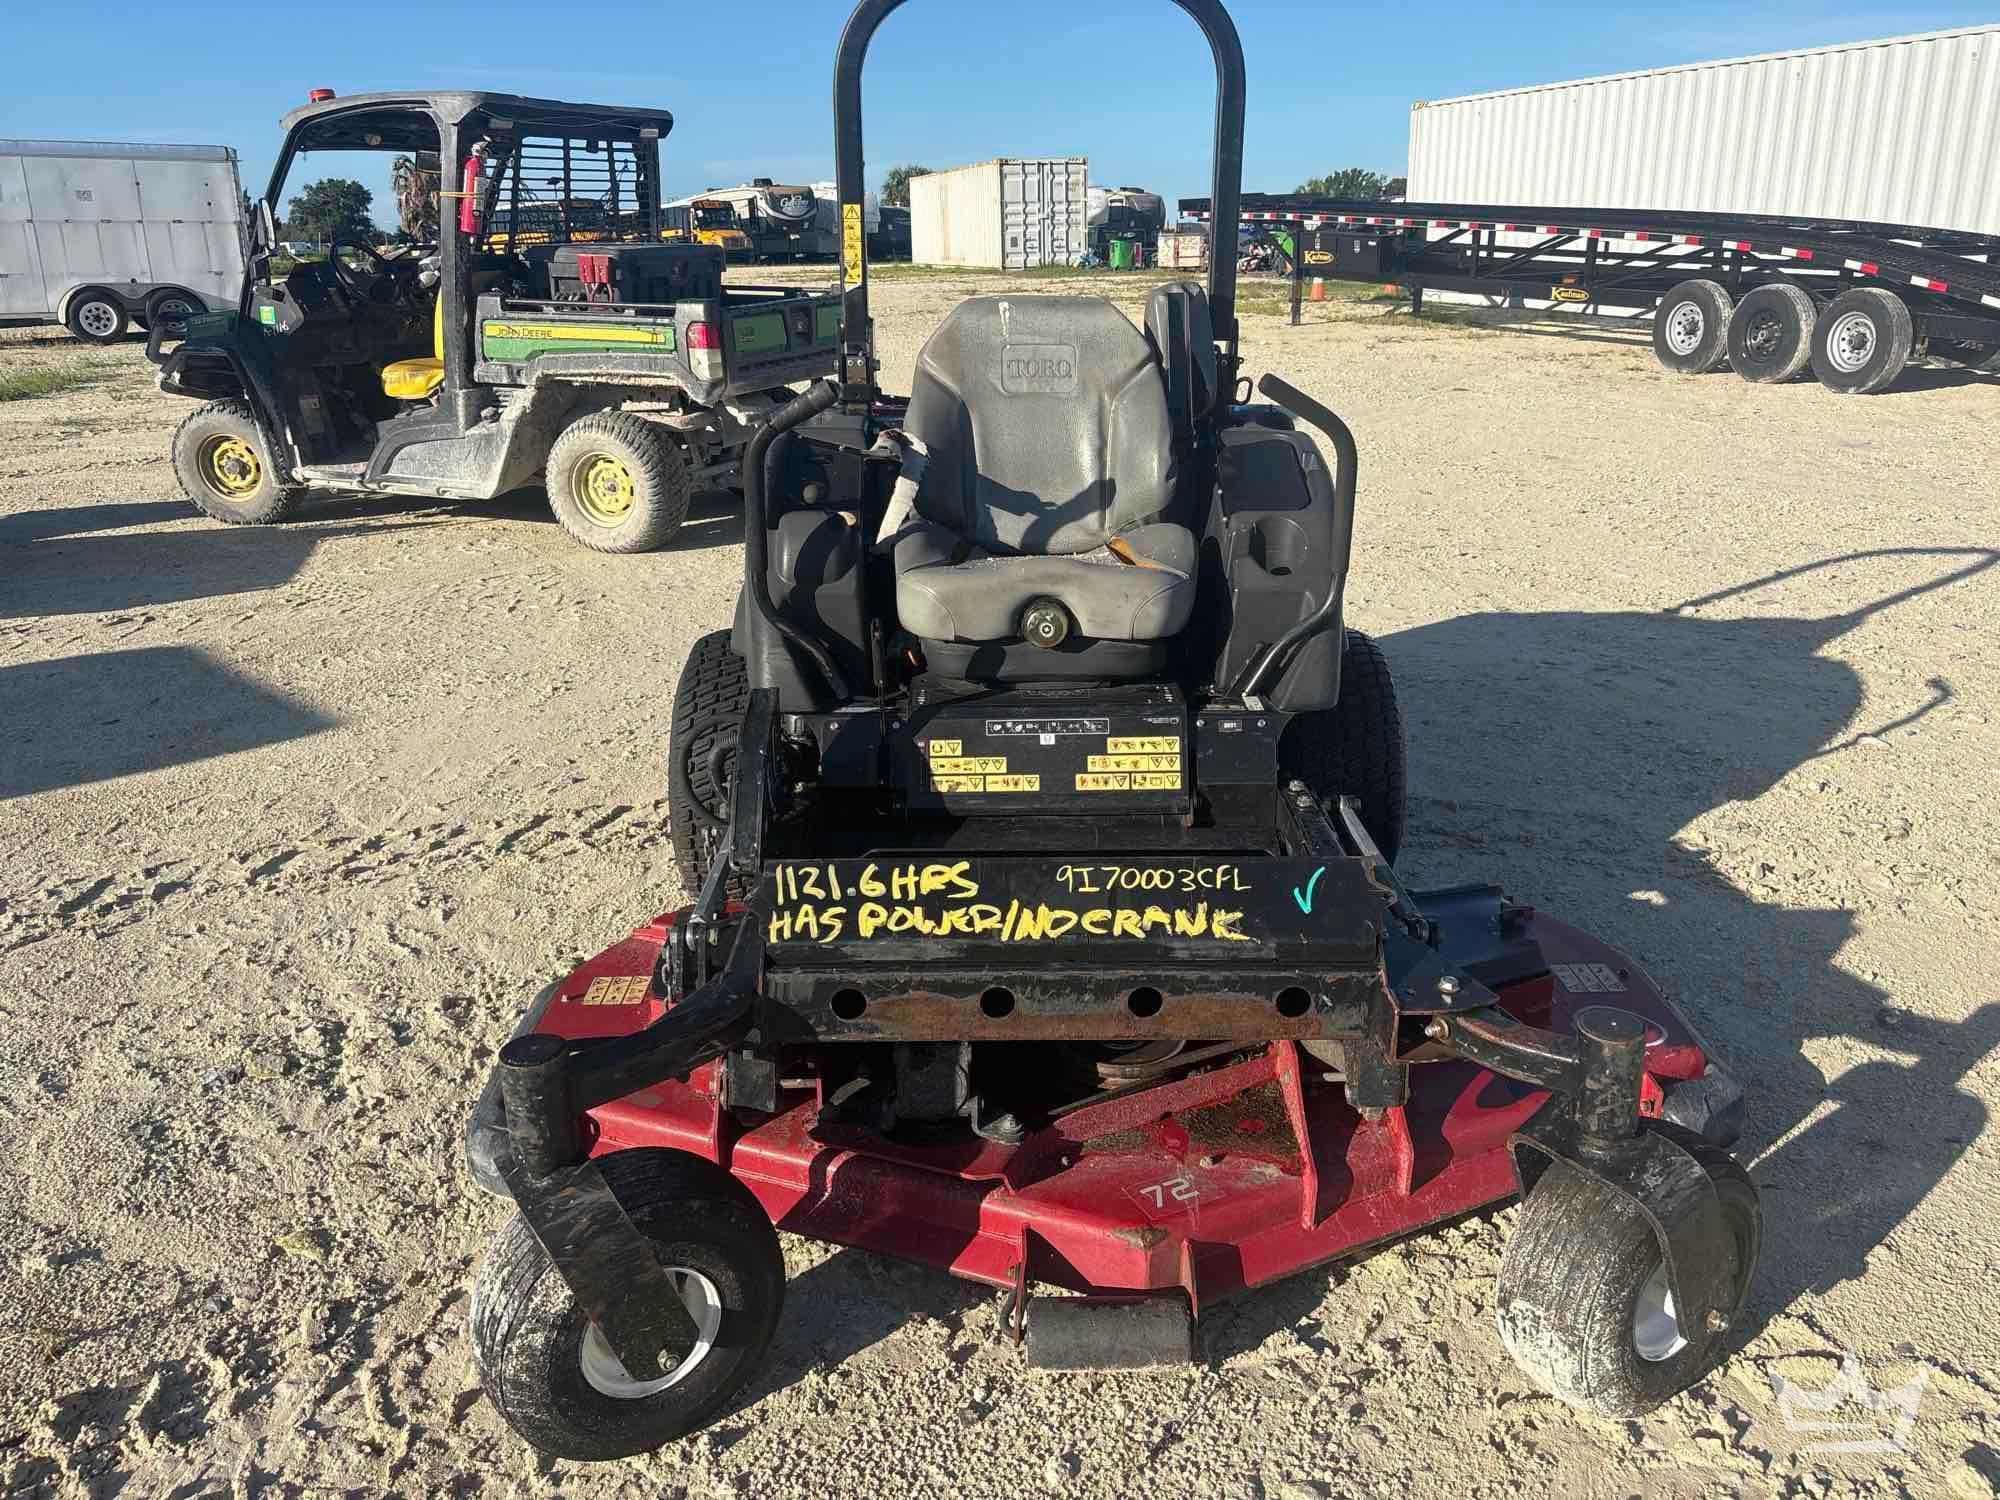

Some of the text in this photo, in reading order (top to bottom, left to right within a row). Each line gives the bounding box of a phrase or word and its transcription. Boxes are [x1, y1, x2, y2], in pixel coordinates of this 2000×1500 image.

[522, 328, 553, 338] DEERE
[1006, 359, 1072, 377] TORO
[768, 903, 847, 944] HAS
[1139, 1177, 1200, 1208] 72
